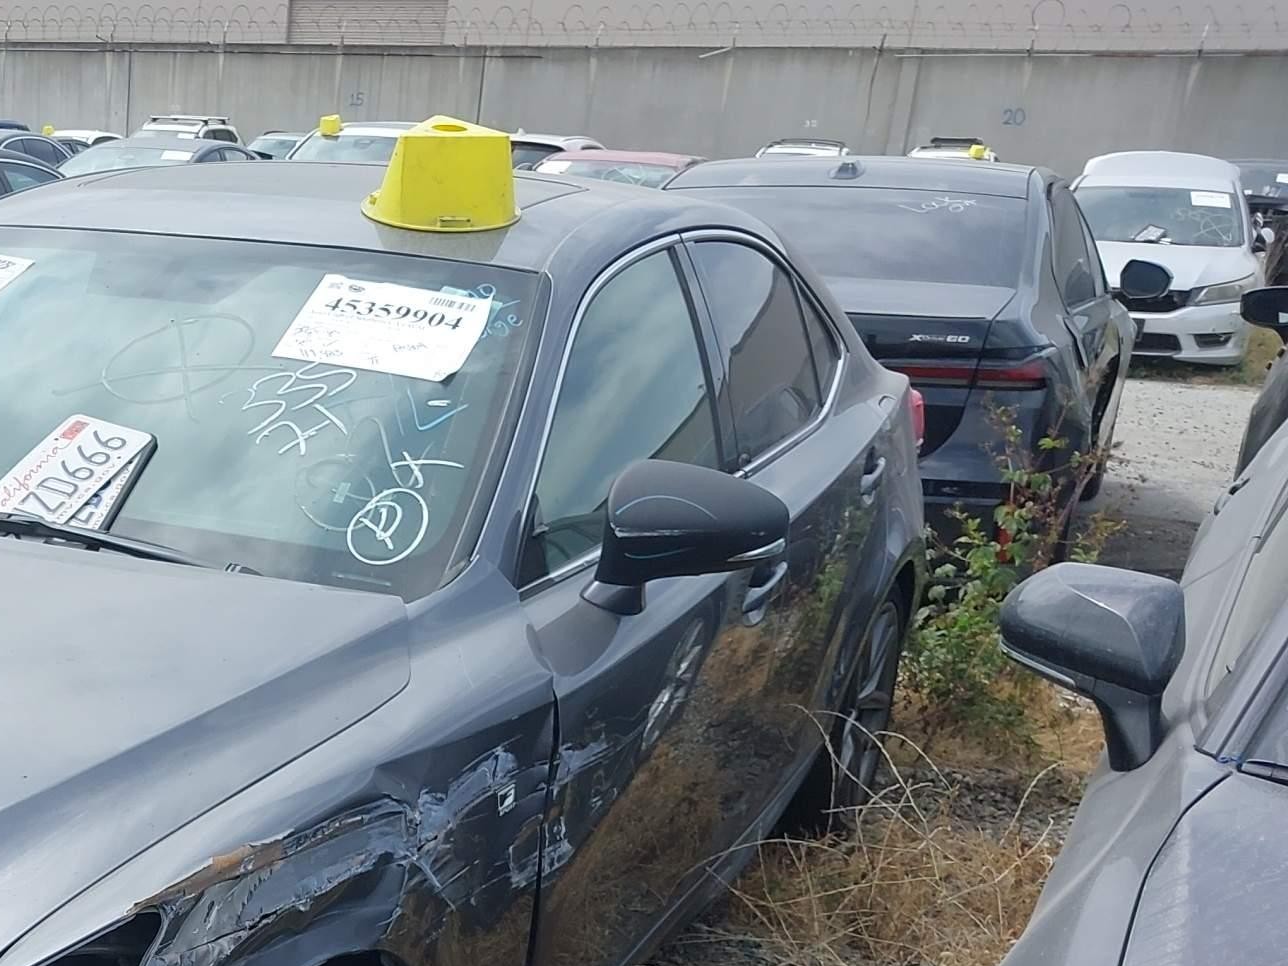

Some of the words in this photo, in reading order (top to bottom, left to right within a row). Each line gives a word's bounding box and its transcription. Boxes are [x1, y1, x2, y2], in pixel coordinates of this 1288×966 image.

[1002, 108, 1026, 126] 20
[324, 297, 464, 331] 45359904
[908, 333, 971, 344] XD60
[14, 429, 127, 519] ZD666
